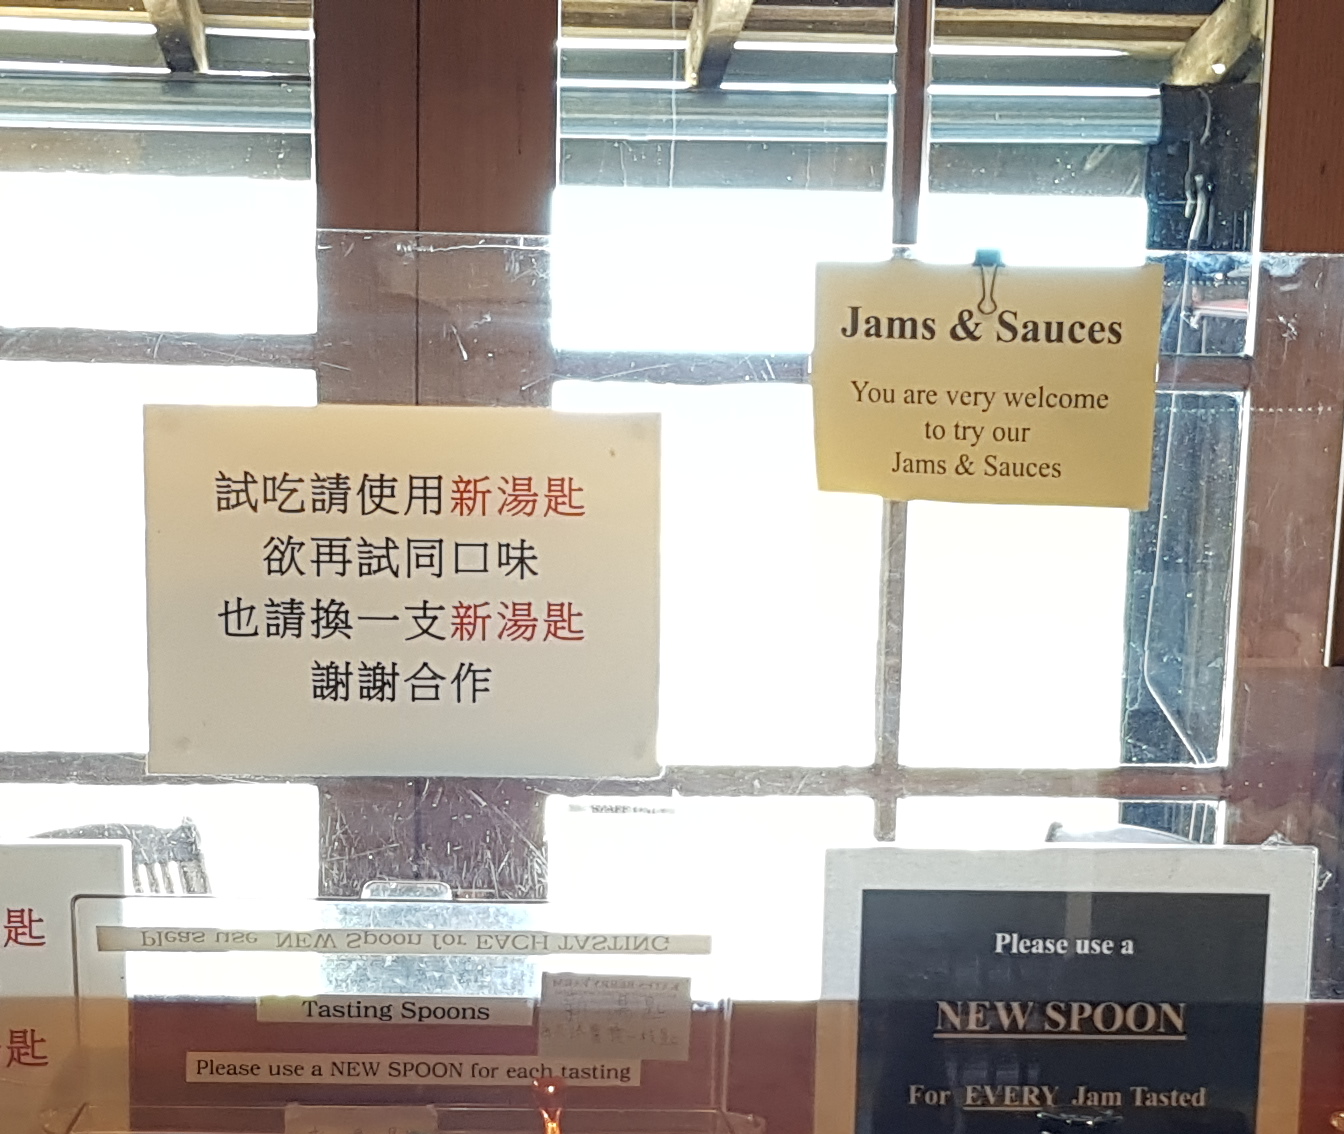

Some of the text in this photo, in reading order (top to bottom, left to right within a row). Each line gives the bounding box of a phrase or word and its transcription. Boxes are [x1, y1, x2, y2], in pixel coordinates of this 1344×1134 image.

[841, 306, 1123, 345] Jams & Sauces
[851, 380, 1109, 412] You are very welcome
[925, 421, 1031, 447] to try our
[891, 451, 1062, 478] Jams & Sauces
[214, 471, 586, 518] 試吃請使用新湯匙
[263, 535, 539, 580] 欲再試同口味
[217, 597, 586, 642] 也請換一支新湯匙
[311, 660, 492, 703] 謝謝合作
[994, 933, 1134, 955] Please use a
[302, 1001, 490, 1021] Tasting Spoons
[935, 1001, 1187, 1033] NEW SPOON
[196, 1059, 631, 1082] Please use a NEW SPOON for each tasting
[908, 1084, 1207, 1108] For EVERY Jam Tasted
